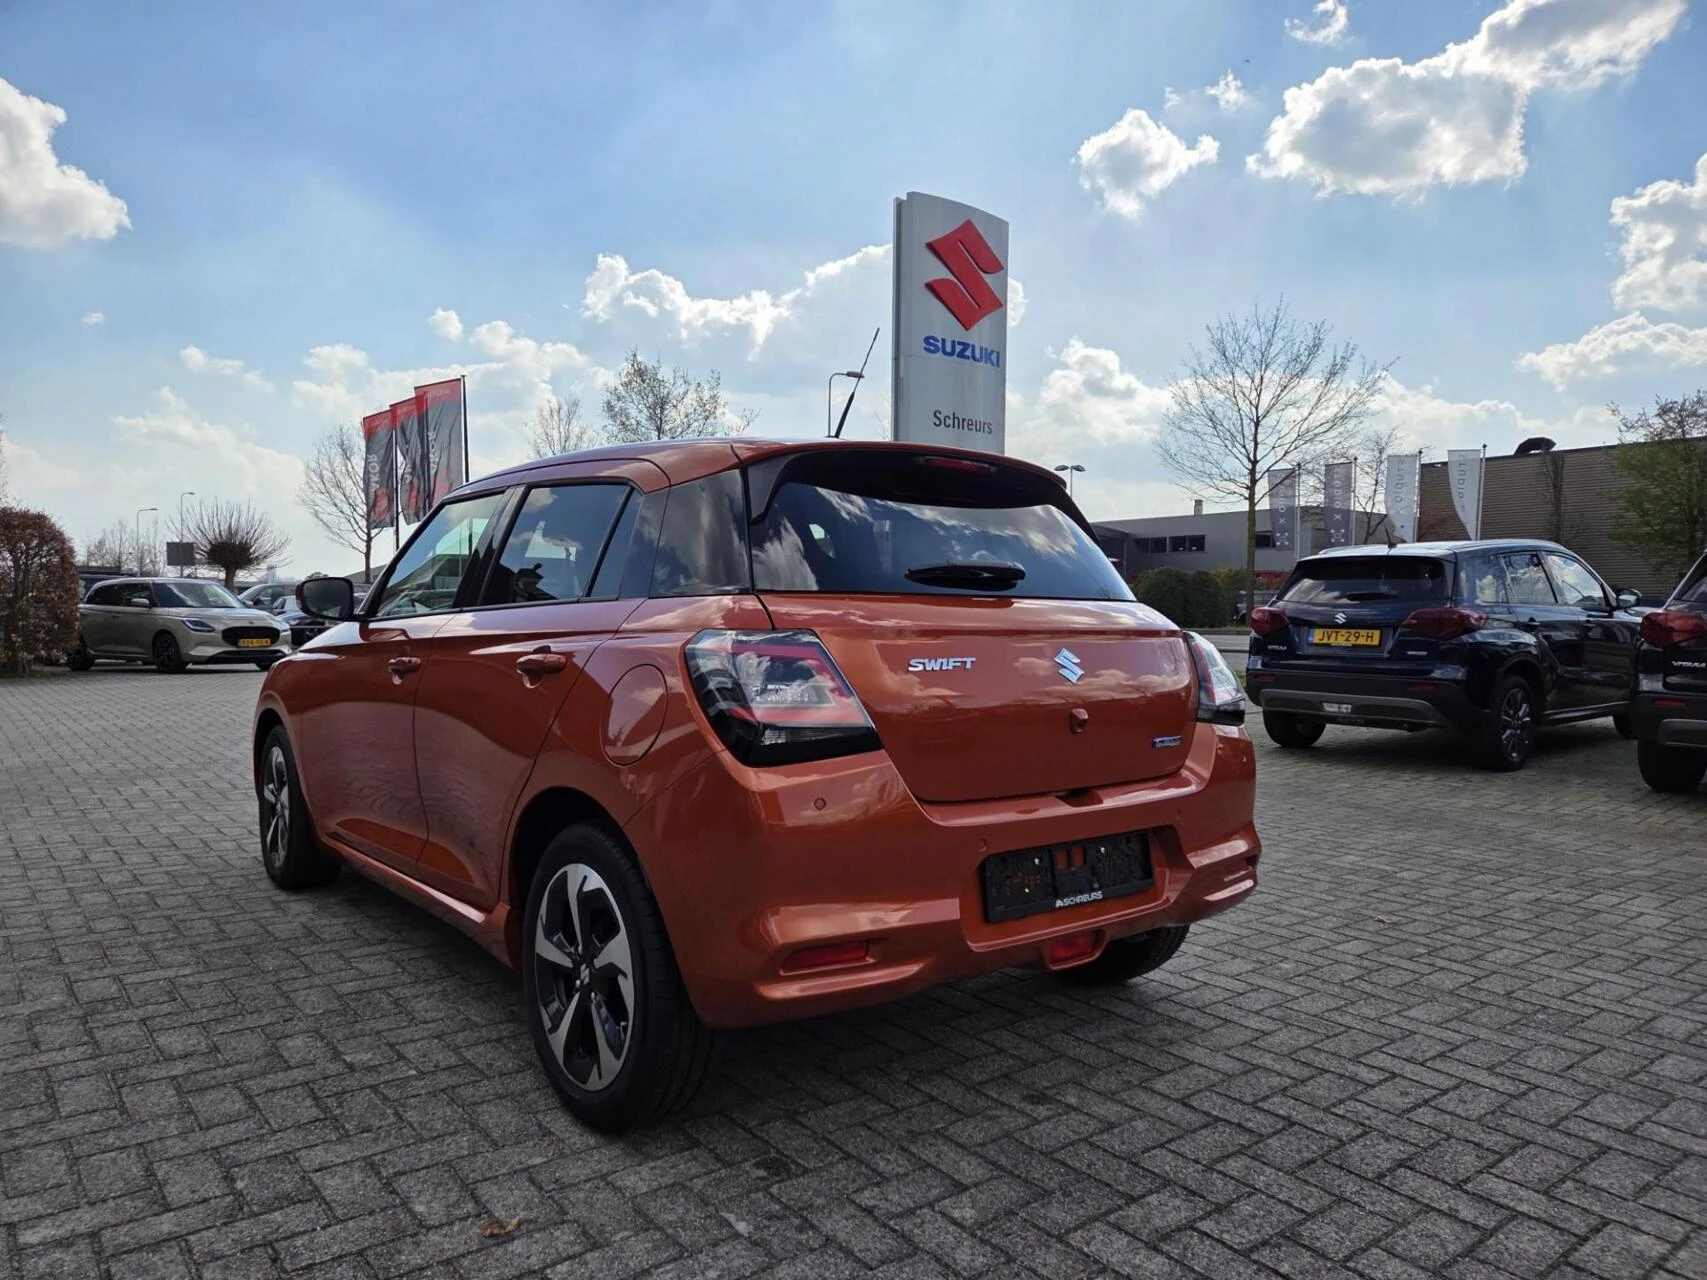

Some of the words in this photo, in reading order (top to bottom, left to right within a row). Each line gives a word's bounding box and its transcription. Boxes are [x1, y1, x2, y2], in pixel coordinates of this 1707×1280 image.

[923, 335, 1000, 368] SUZUKI
[932, 410, 993, 435] Schreurs
[1318, 630, 1375, 643] JVT-29-H
[908, 657, 976, 671] SWIFT
